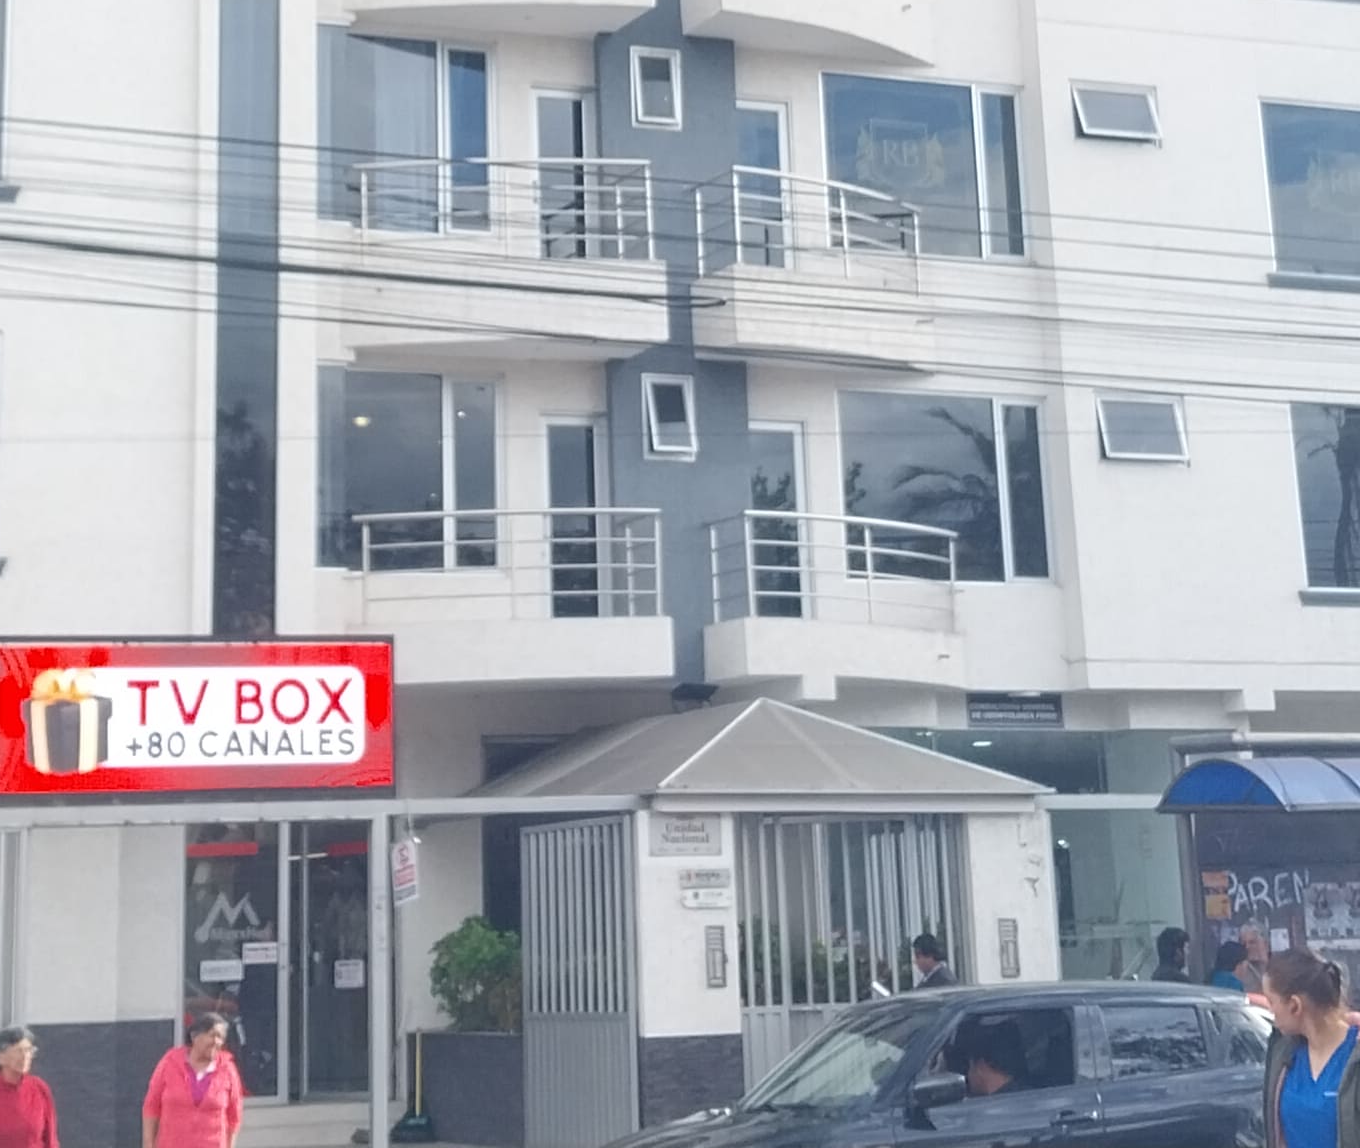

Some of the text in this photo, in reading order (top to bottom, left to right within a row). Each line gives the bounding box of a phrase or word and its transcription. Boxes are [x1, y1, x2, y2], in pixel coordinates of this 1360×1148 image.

[127, 678, 353, 726] TV BOX
[126, 728, 356, 758] +80 CANALES
